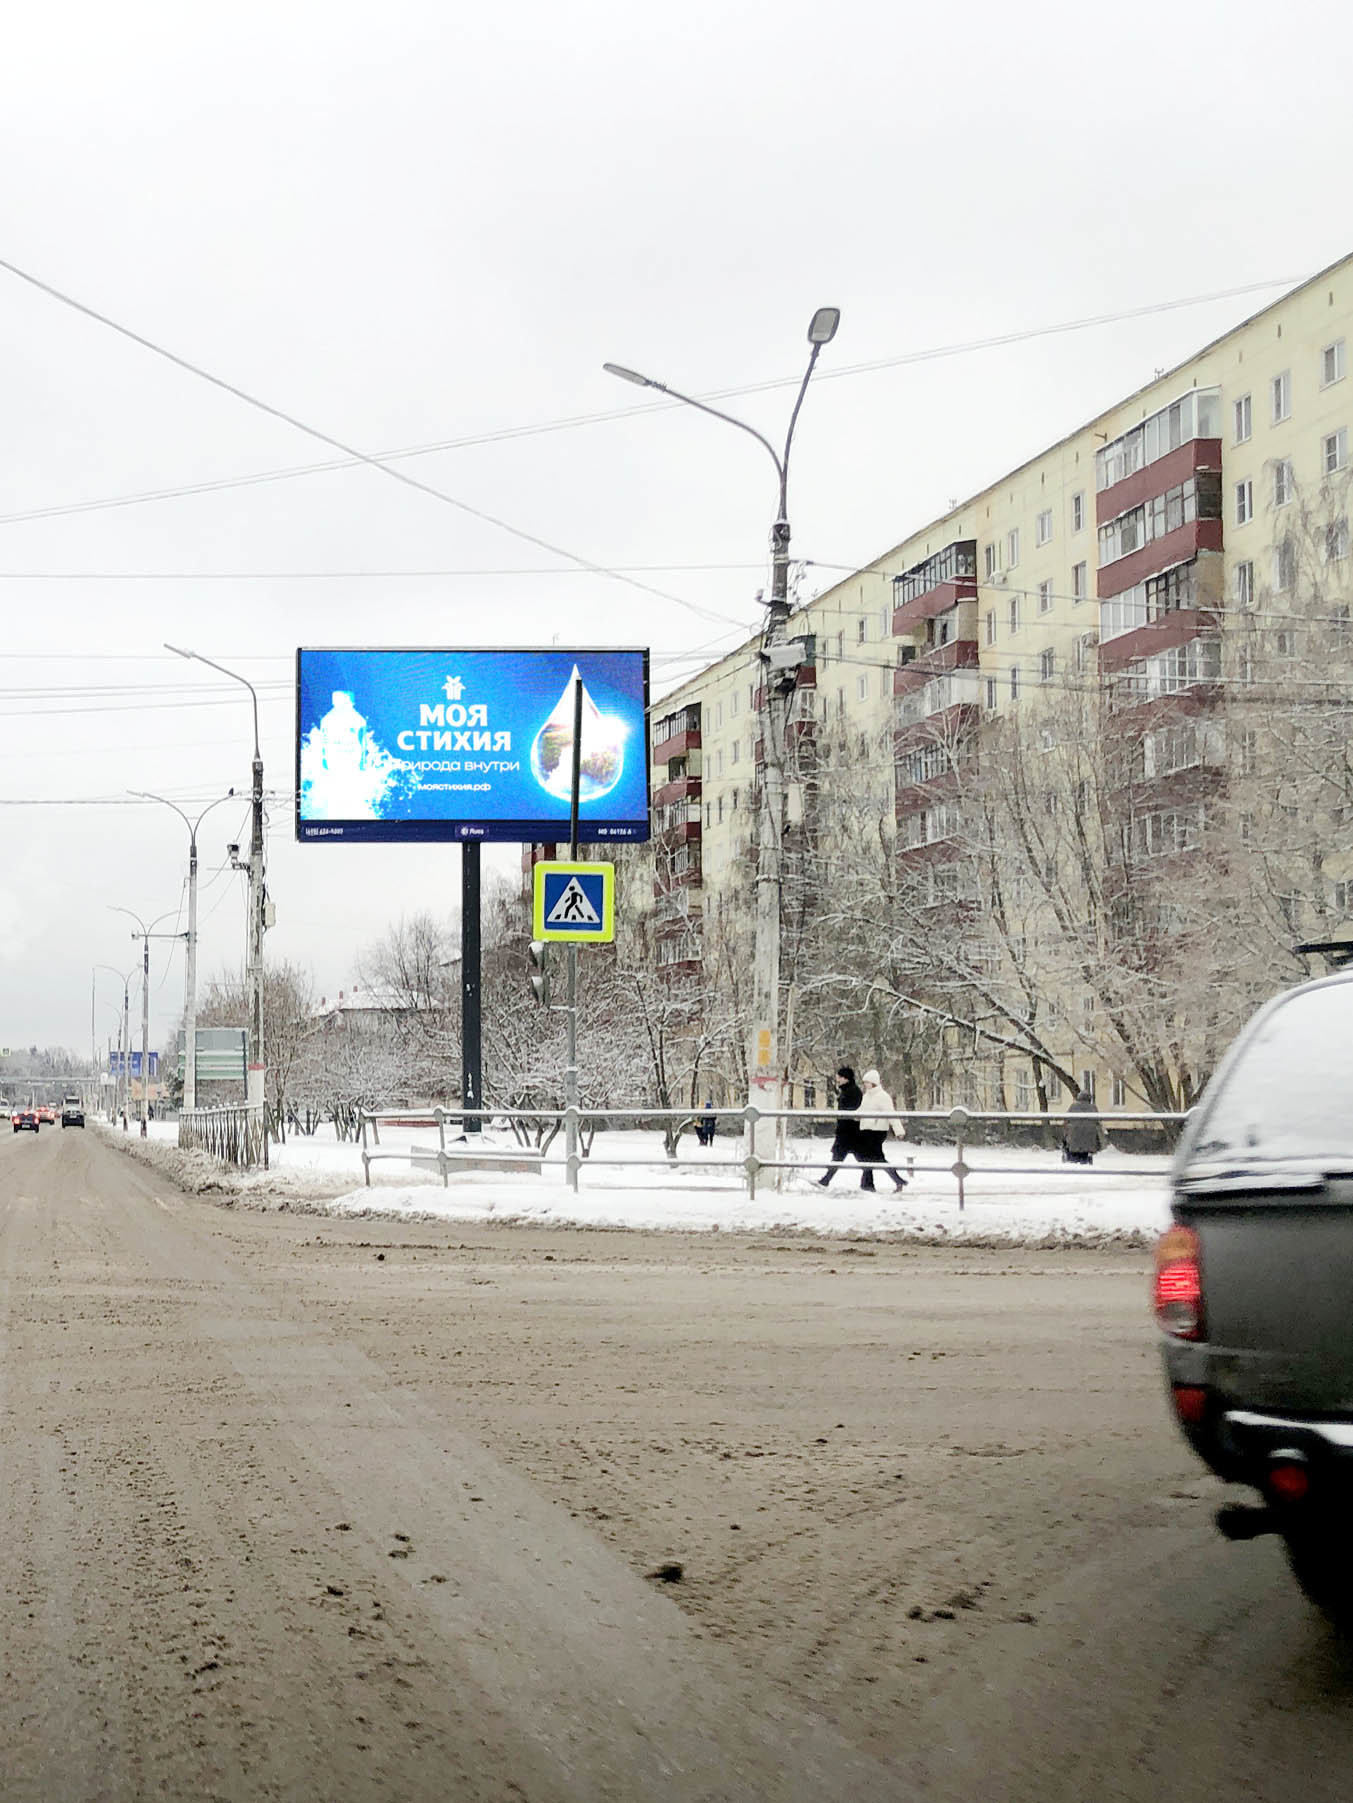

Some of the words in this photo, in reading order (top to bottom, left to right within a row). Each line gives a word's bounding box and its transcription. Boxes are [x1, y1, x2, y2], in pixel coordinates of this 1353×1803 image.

[419, 704, 488, 727] МОЯ
[397, 730, 511, 751] СТИХИЯ
[391, 761, 461, 772] рирода
[464, 761, 520, 773] внутри
